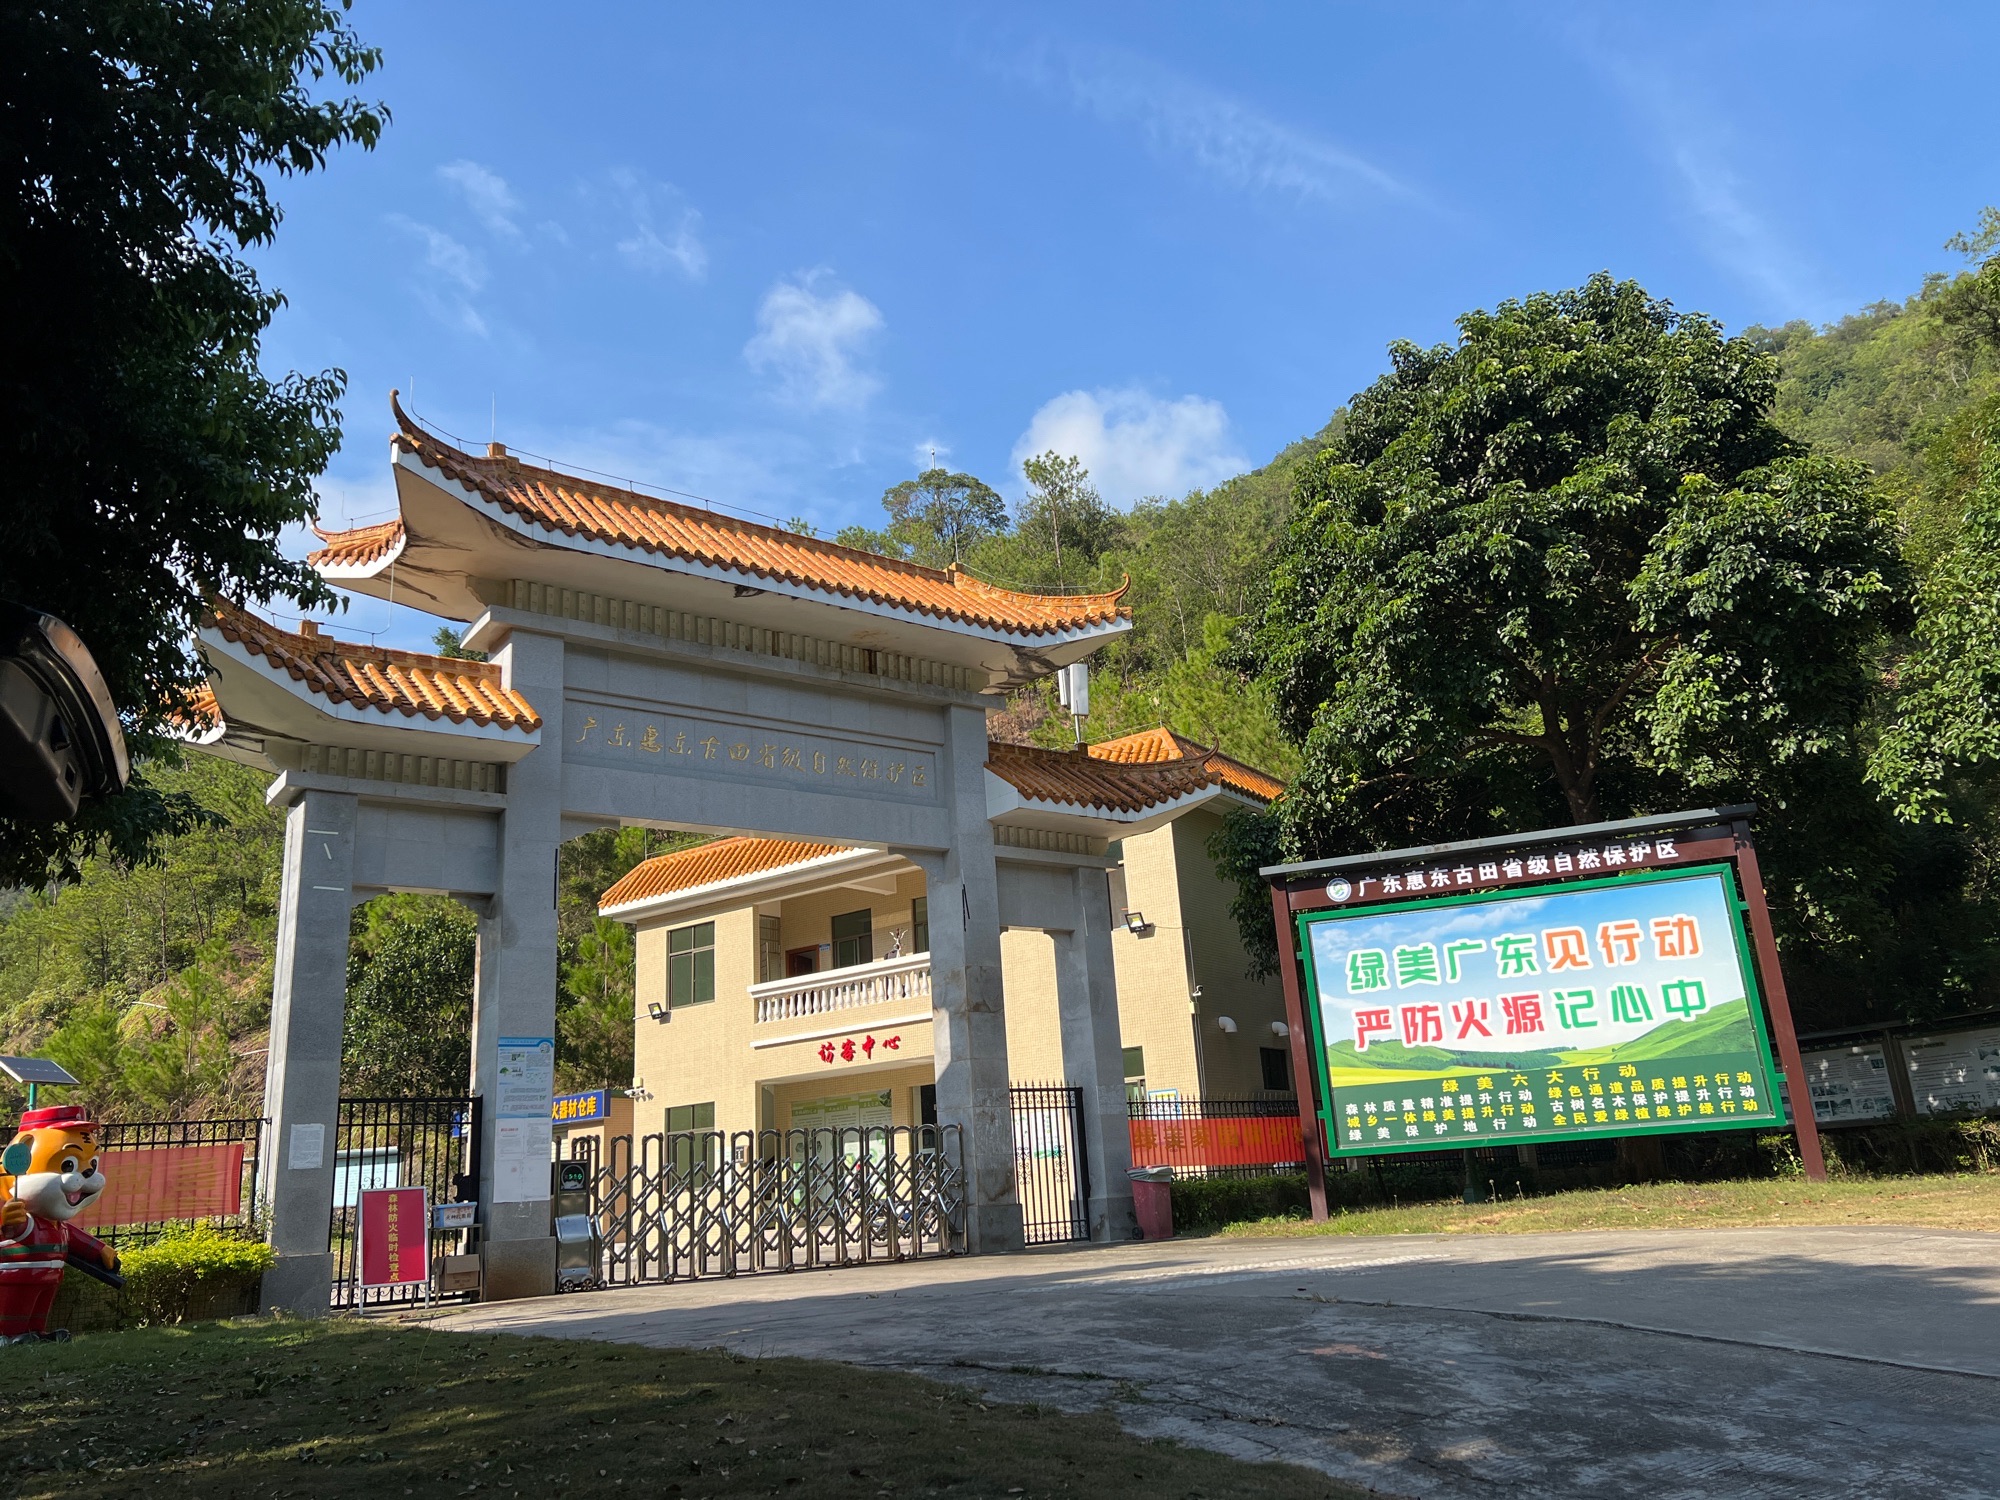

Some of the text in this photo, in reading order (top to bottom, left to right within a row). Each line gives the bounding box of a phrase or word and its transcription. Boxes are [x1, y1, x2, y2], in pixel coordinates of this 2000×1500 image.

[1359, 838, 1679, 897] 广东惠东古田省级自然保护区
[1348, 916, 1701, 991] 绿美广东见行动
[1352, 979, 1707, 1049] 严防火源记心中
[818, 1034, 901, 1064] 访客中心
[1442, 1064, 1637, 1093] 绿美六大行动
[1548, 1071, 1752, 1099] 绿色通道品质提升行动
[1345, 1089, 1532, 1116] 森林质量精准提升行动
[1550, 1085, 1756, 1113] 古树名木保护提升行动
[1553, 1099, 1759, 1126] 全民爱绿植绿护绿行动
[1347, 1102, 1535, 1128] 城乡一体绿美提升行动
[1349, 1115, 1537, 1141] 绿美保护地行动
[388, 1193, 400, 1283] 森林防火临时检查点
